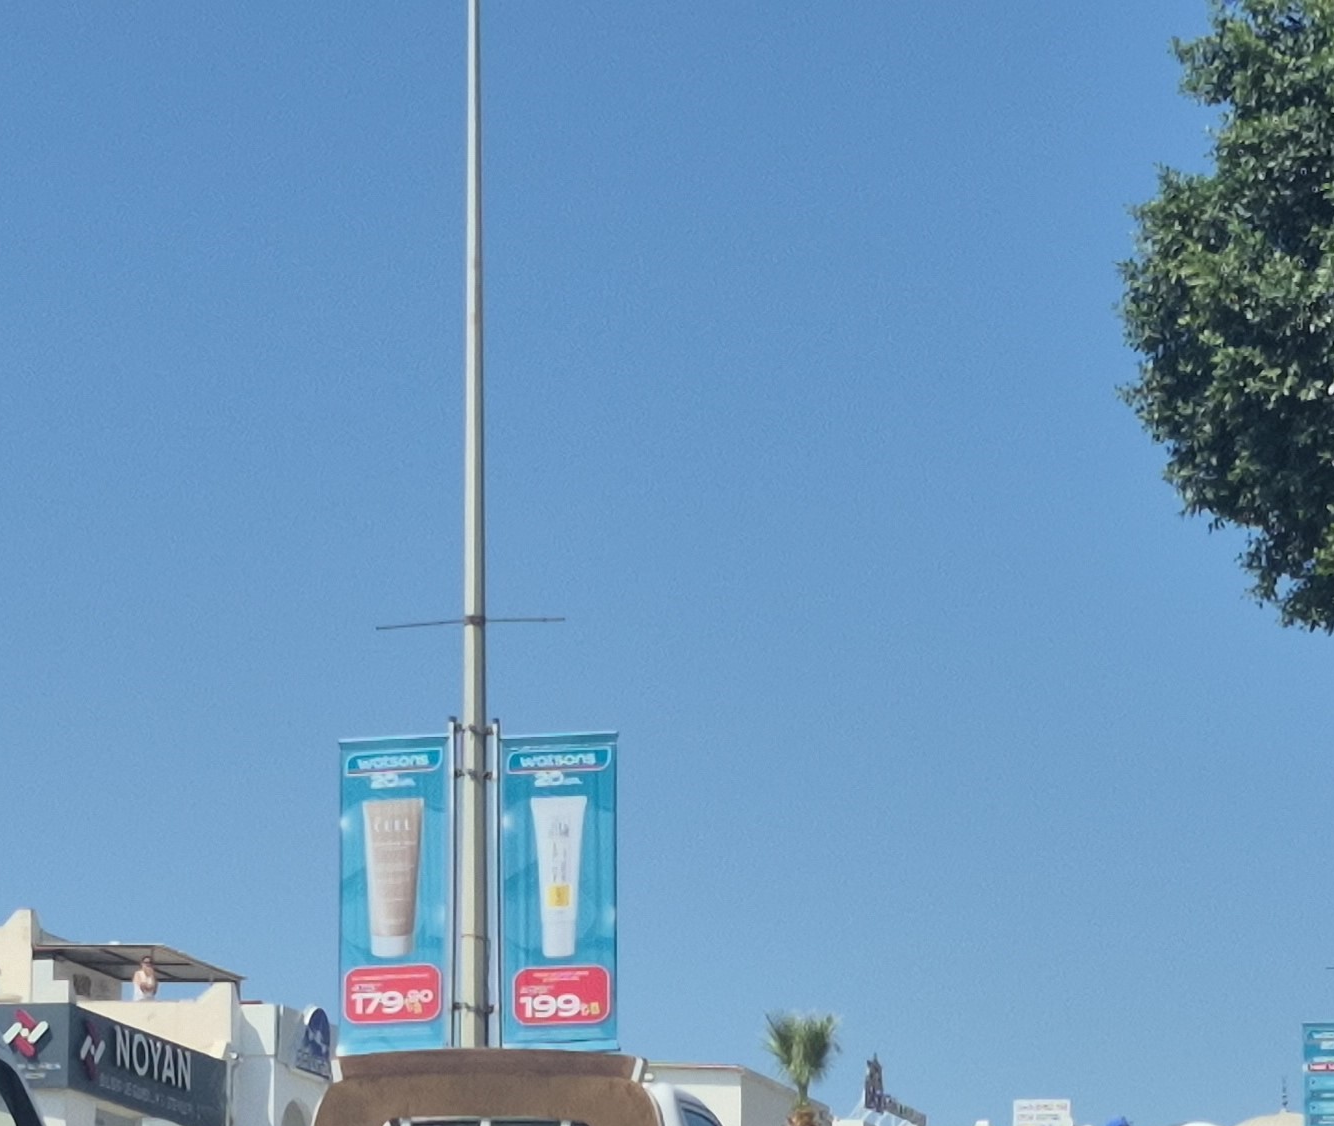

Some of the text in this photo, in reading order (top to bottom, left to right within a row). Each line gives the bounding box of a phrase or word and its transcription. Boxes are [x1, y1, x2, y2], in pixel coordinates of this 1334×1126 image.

[357, 754, 429, 770] watsons
[519, 752, 596, 768] watsons
[519, 993, 581, 1018] 199
[114, 1025, 192, 1092] NOYAN
